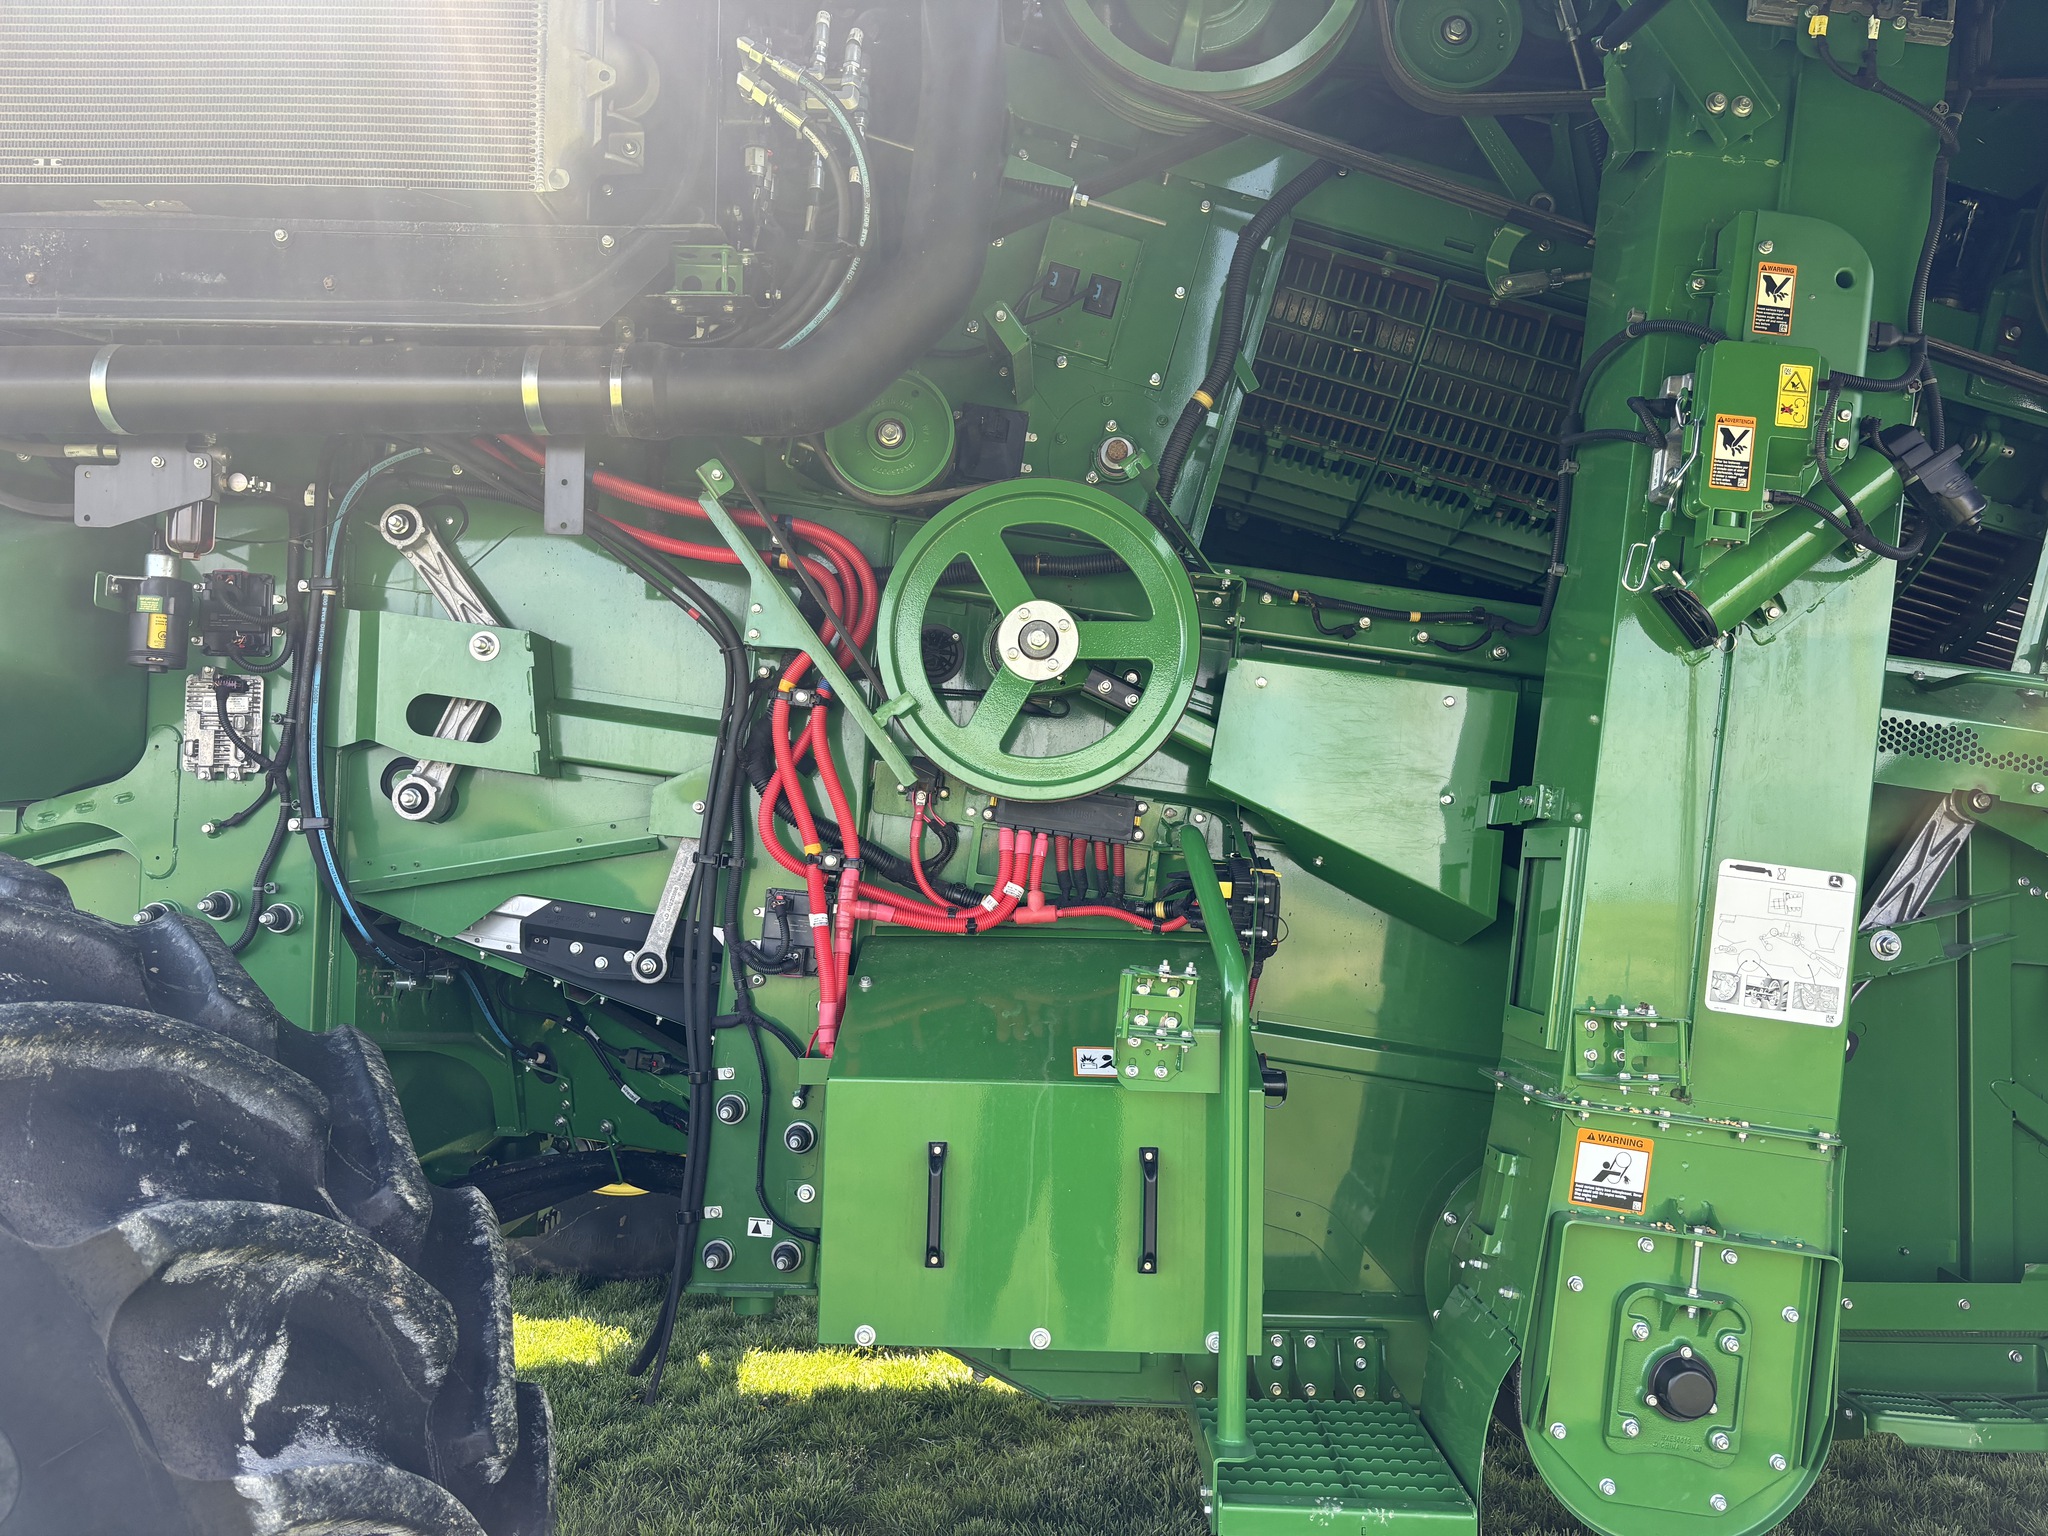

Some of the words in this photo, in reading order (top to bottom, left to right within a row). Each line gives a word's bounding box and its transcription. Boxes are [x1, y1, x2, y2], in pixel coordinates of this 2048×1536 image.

[1767, 265, 1795, 274] WARNING
[1724, 417, 1754, 425] ADVERTENCIA
[1598, 1133, 1644, 1148] WARNING
